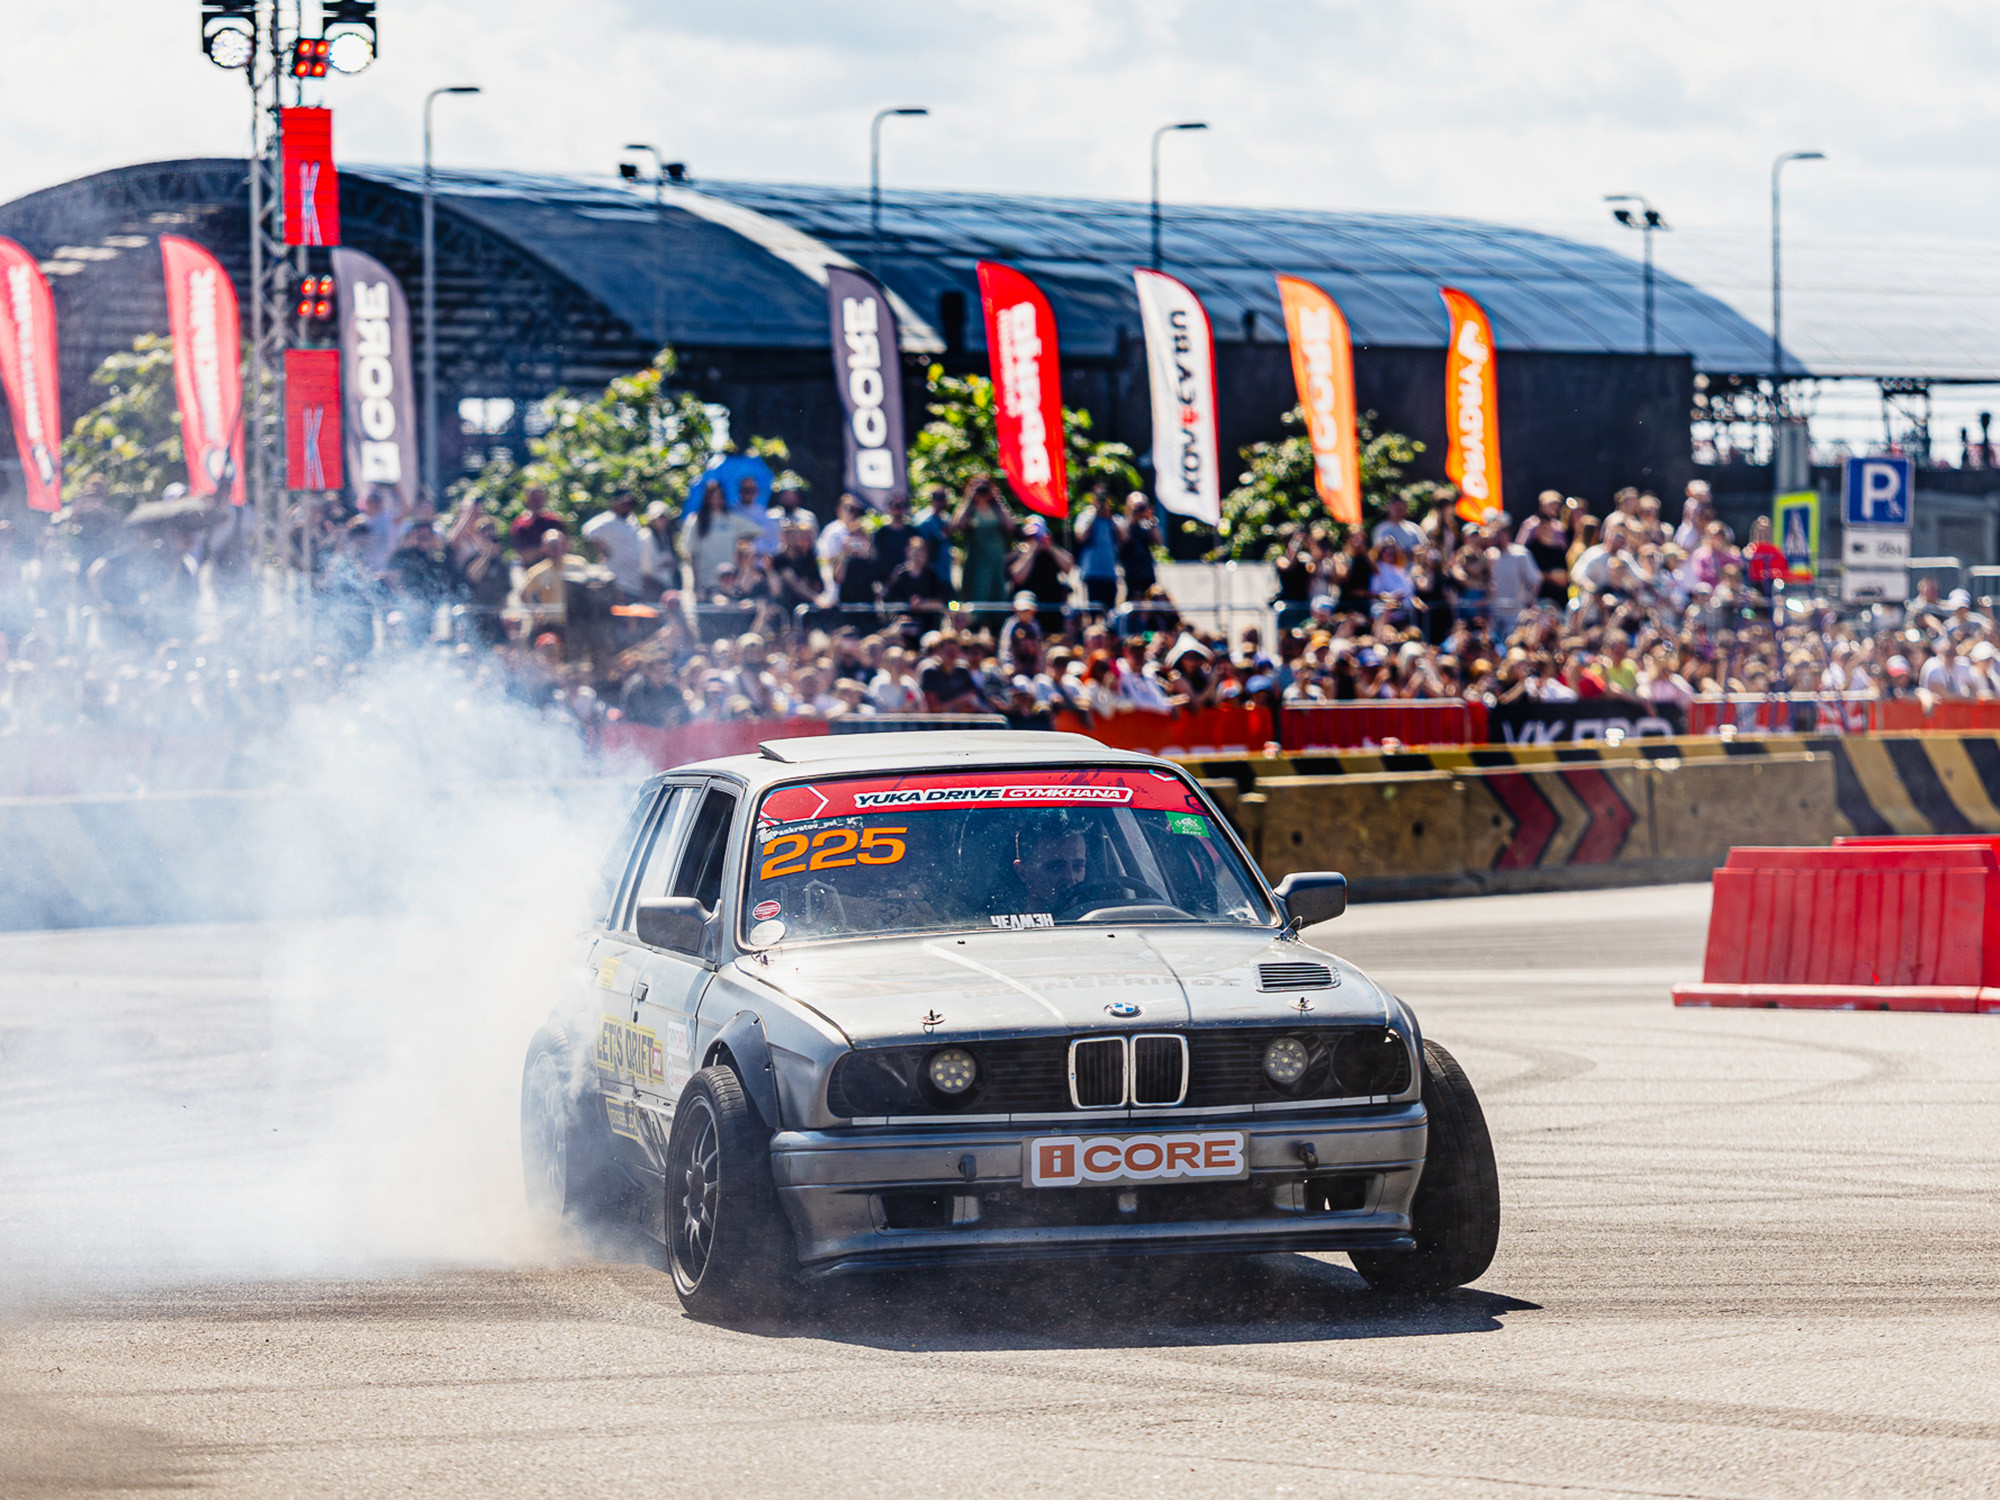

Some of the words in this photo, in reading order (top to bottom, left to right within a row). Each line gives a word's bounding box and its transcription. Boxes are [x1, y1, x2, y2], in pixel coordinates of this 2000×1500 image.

[1862, 463, 1900, 518] P
[857, 791, 920, 806] YUKA
[926, 788, 1001, 802] DRIVE
[1008, 788, 1121, 799] GYMKHANA
[760, 827, 908, 881] 225
[625, 1029, 654, 1079] DRIFT
